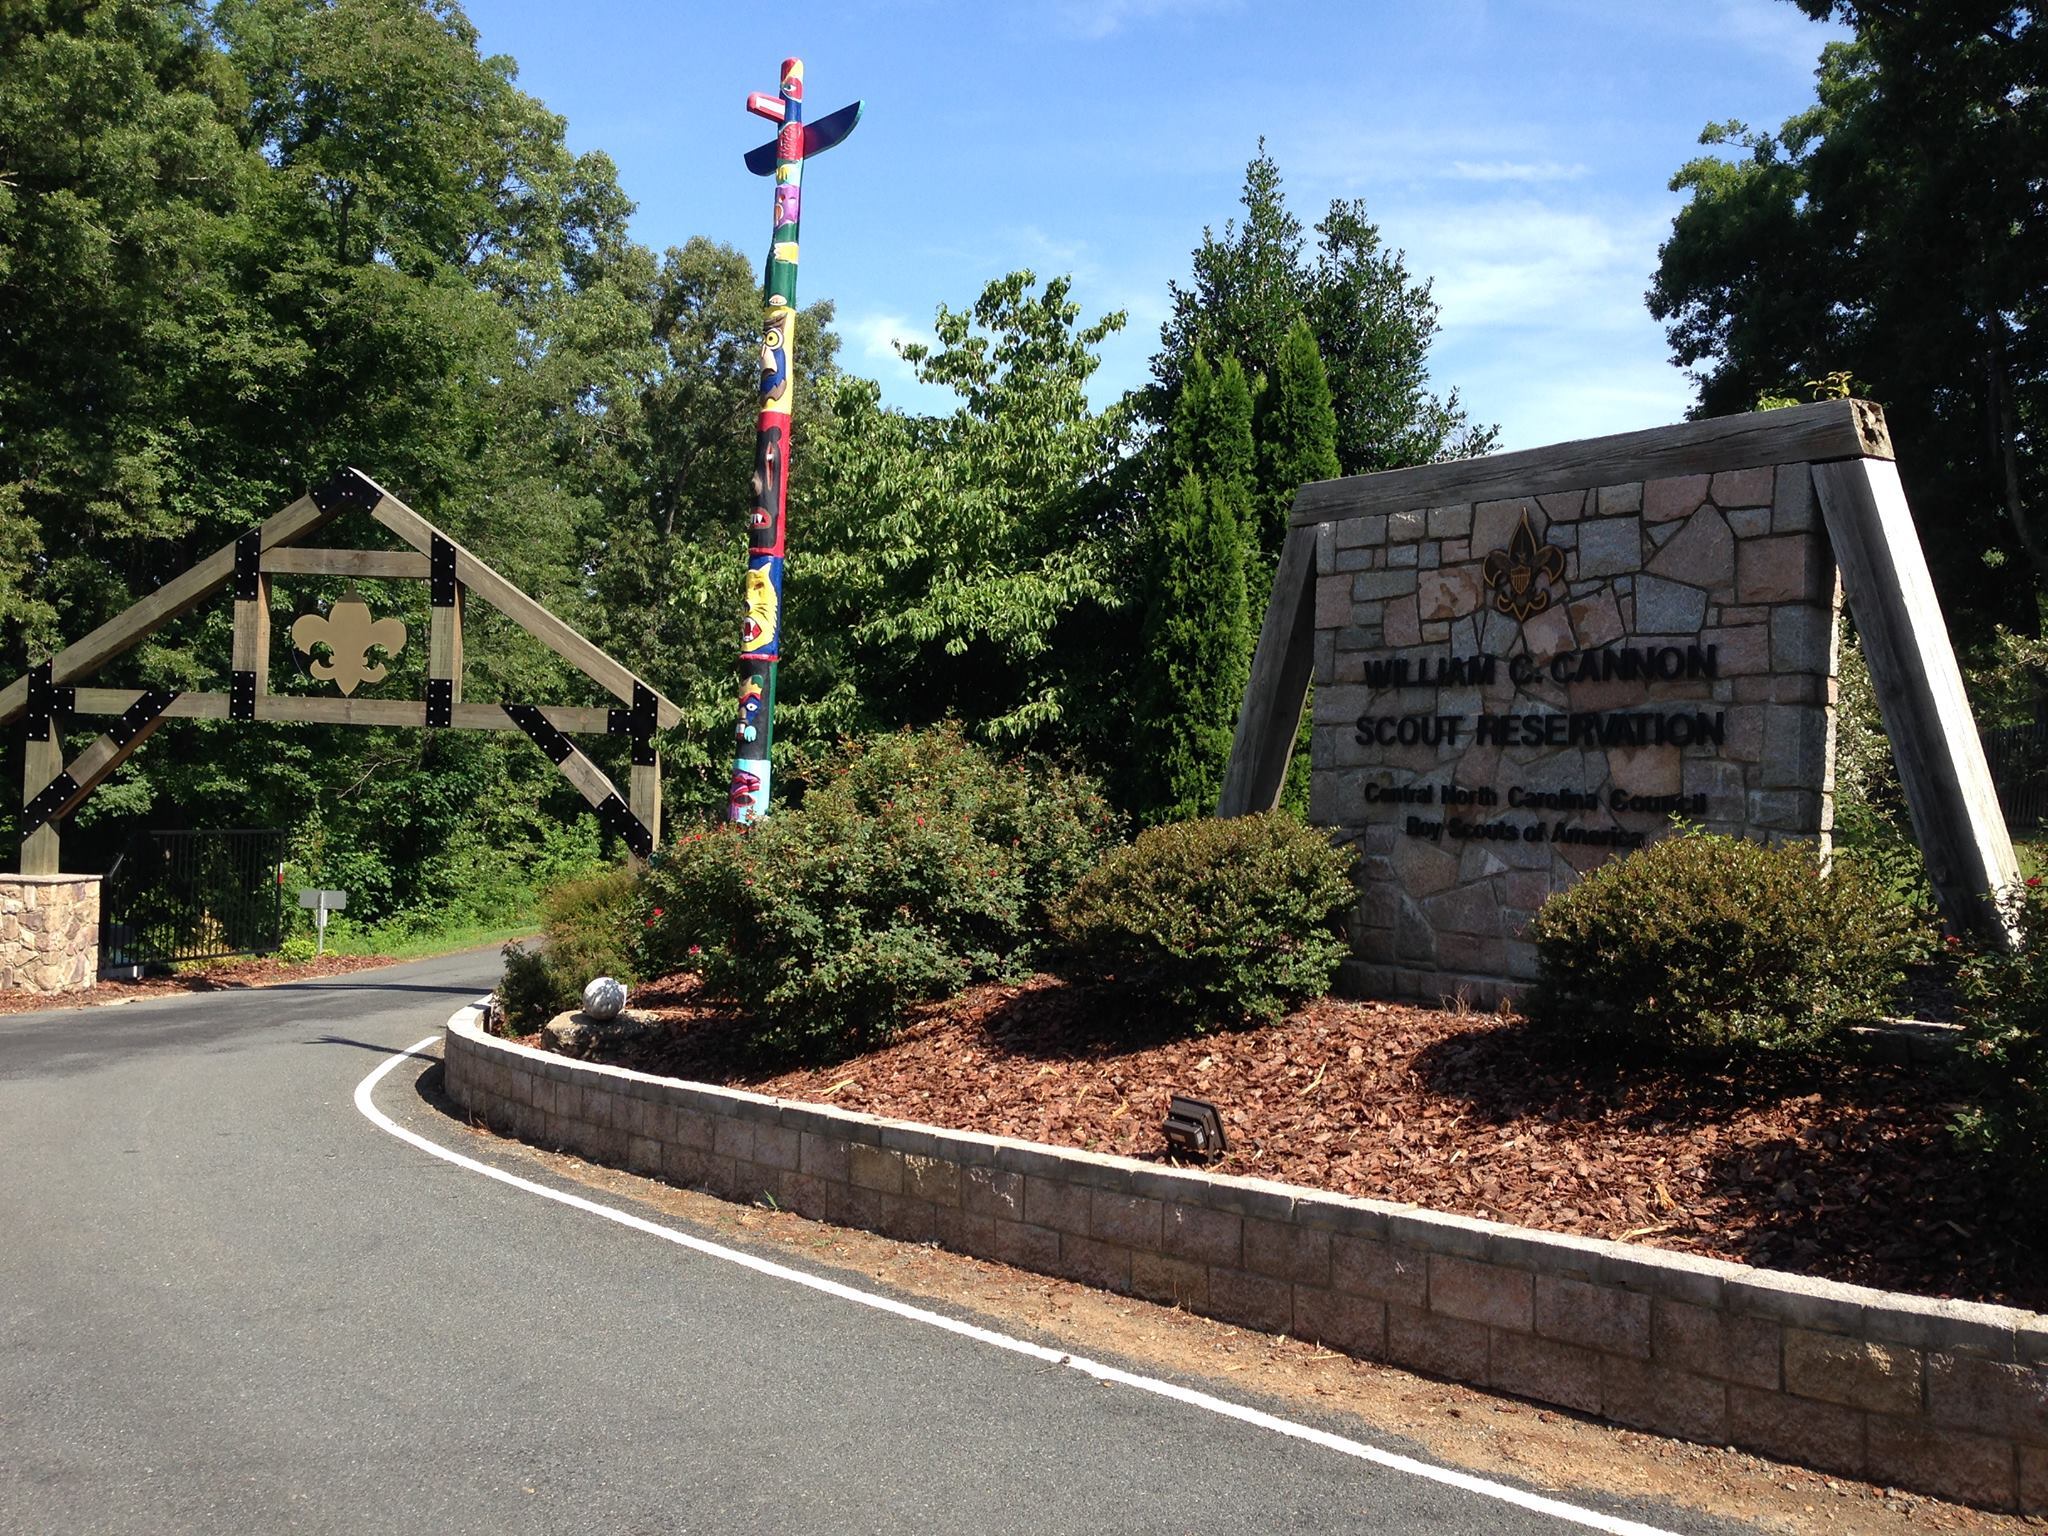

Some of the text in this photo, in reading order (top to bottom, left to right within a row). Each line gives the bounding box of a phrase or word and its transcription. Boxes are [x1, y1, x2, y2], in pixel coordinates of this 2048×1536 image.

[1364, 644, 1717, 689] WILLIAM C. CANNON
[1355, 711, 1724, 747] SCOUT RESERVATION
[1364, 782, 1706, 814] Central North Carolina Council
[1407, 816, 1643, 847] Boy Scouts of America
